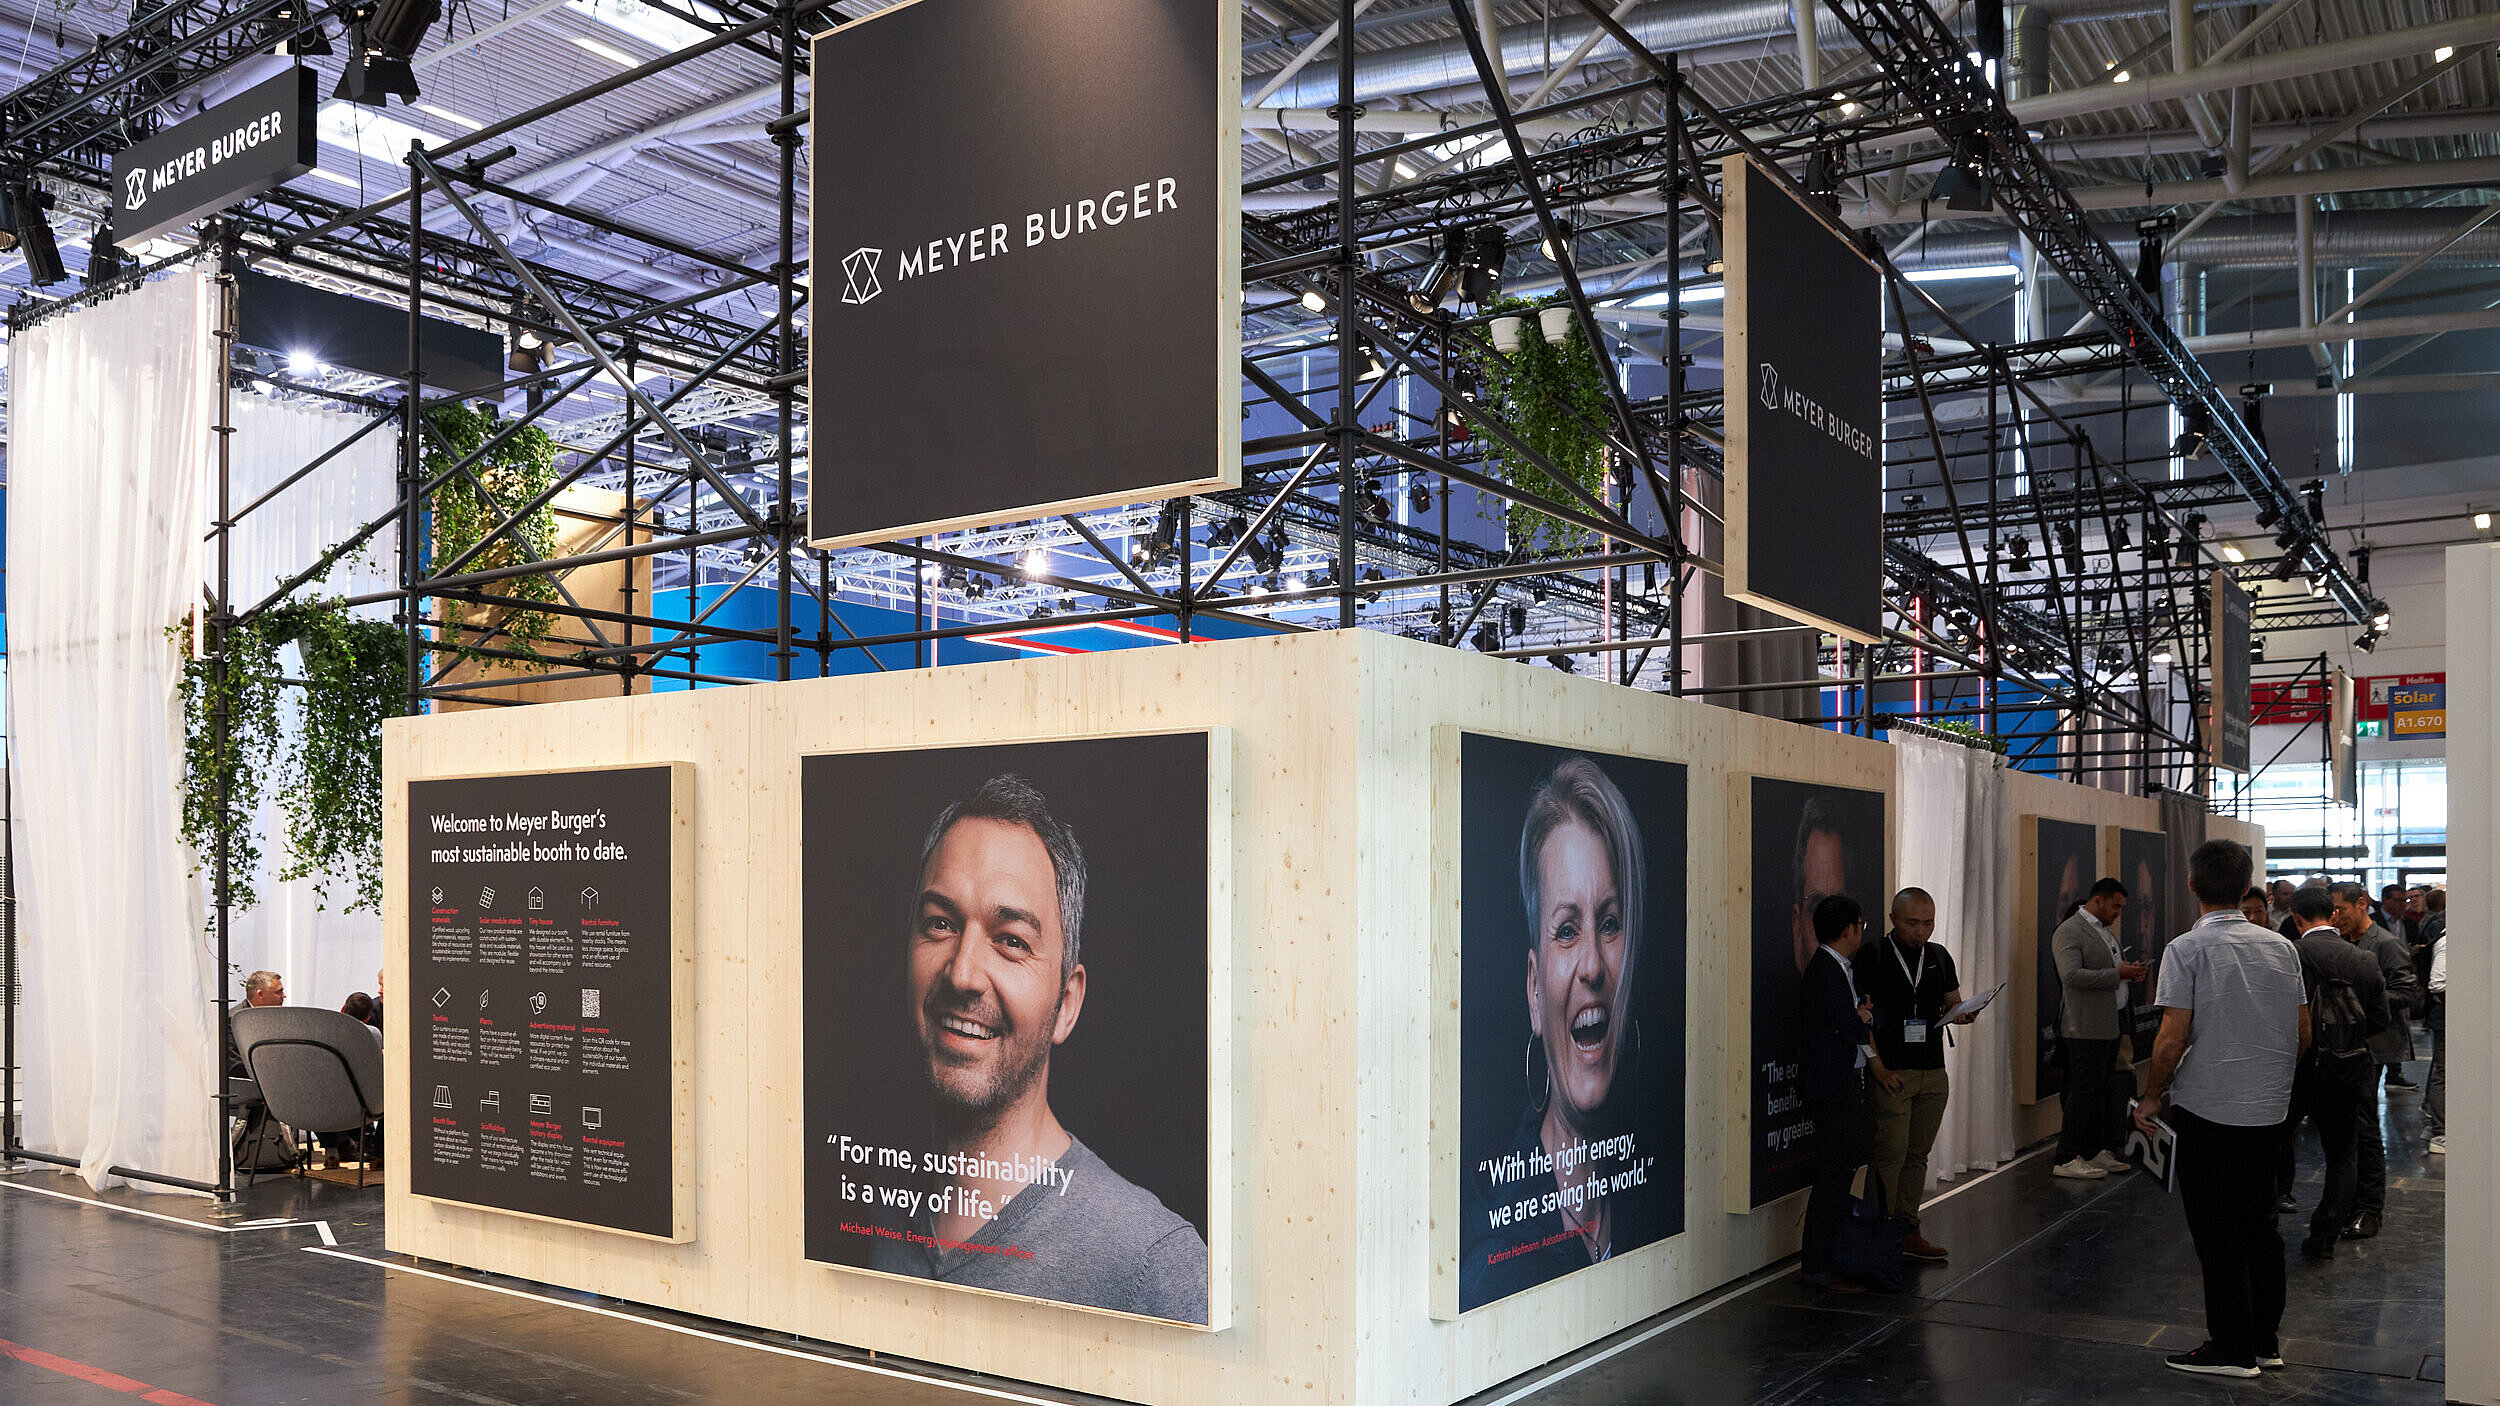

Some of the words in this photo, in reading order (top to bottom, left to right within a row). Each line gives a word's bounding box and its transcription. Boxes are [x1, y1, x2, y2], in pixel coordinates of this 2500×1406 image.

[152, 147, 206, 193] MEYER
[211, 111, 282, 165] BURGER
[898, 223, 1009, 281] MEYER
[1026, 177, 1178, 247] BURGER
[1784, 385, 1824, 431] MEYER
[1828, 412, 1872, 460] BURGER
[2394, 691, 2436, 704] solar
[2397, 717, 2442, 728] A1.670
[430, 812, 487, 833] Welcome
[489, 814, 503, 832] to
[506, 813, 549, 836] Meyer
[431, 845, 461, 863] most
[462, 841, 531, 863] sustainable
[533, 840, 572, 862] booth
[575, 843, 590, 861] to
[593, 839, 628, 861] date.
[1767, 1129, 1781, 1152] my
[1782, 1120, 1816, 1149] greates
[826, 1134, 873, 1165] “For
[878, 1148, 917, 1174] me,
[923, 1150, 1075, 1197] sustainability
[1478, 1150, 1526, 1188] “With
[1529, 1146, 1552, 1177] the
[1555, 1136, 1588, 1176] right
[1590, 1132, 1636, 1162] energy,
[840, 1174, 856, 1202] is
[861, 1184, 874, 1204] a
[879, 1186, 923, 1217] way
[927, 1185, 953, 1214] of
[1488, 1205, 1511, 1230] we
[1514, 1197, 1538, 1222] are
[1541, 1181, 1584, 1212] saving
[1586, 1170, 1608, 1199] the
[840, 1221, 874, 1237] Michael
[906, 1230, 937, 1248] Energy
[939, 1237, 1001, 1255] management
[1002, 1242, 1035, 1260] officer
[1487, 1249, 1512, 1265] Kathrin
